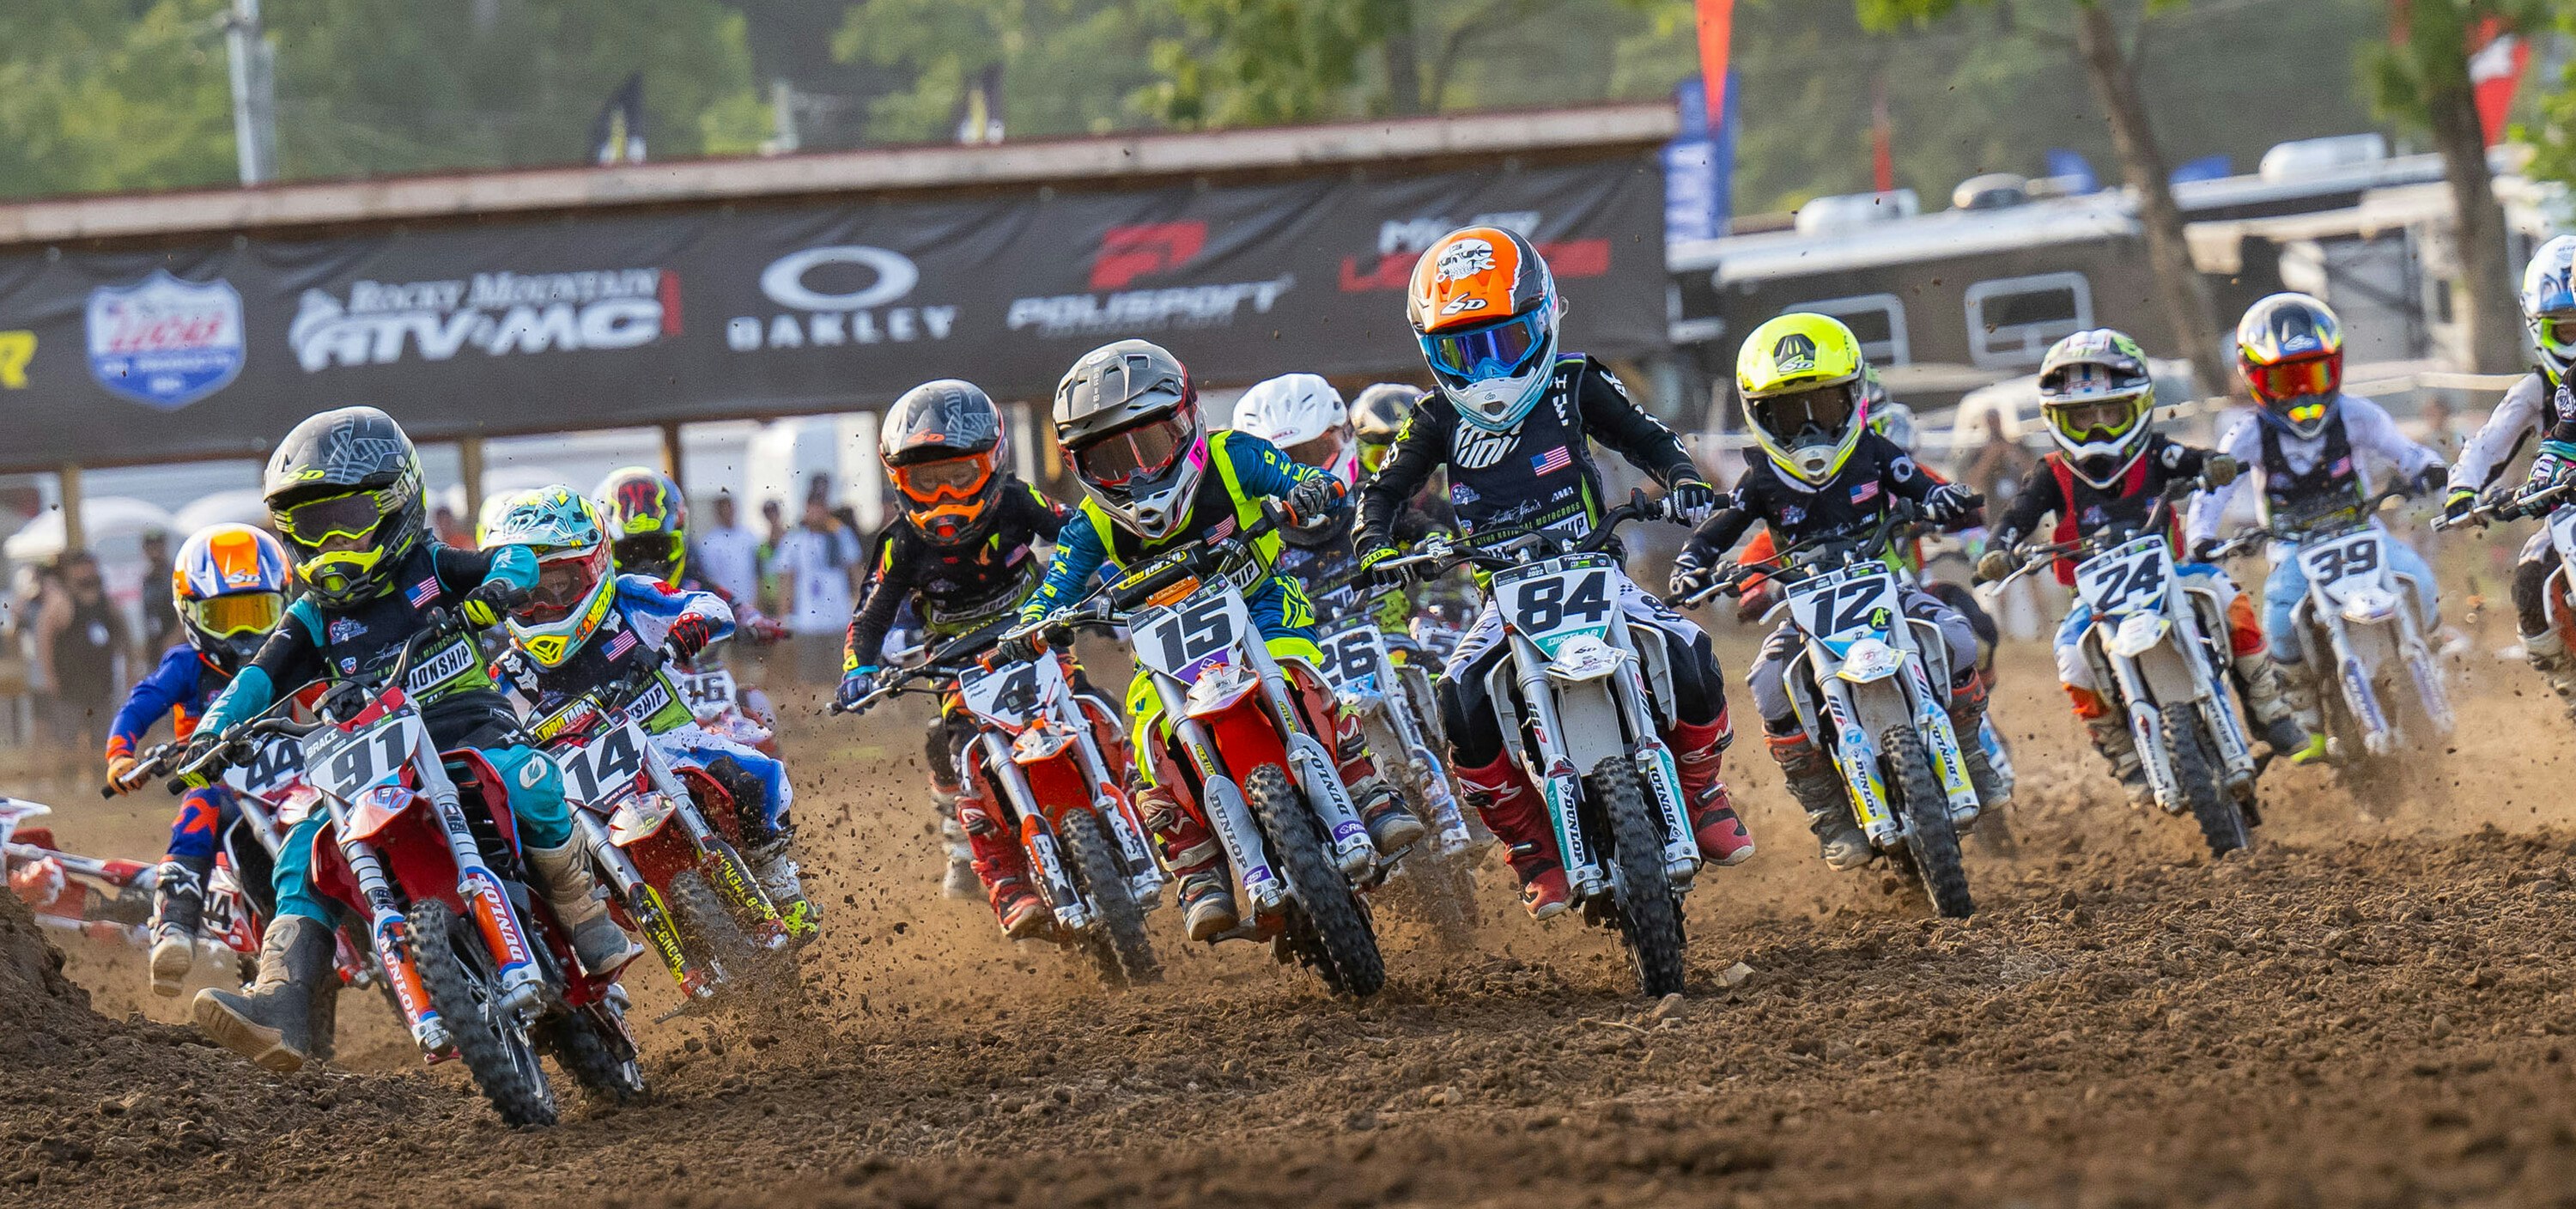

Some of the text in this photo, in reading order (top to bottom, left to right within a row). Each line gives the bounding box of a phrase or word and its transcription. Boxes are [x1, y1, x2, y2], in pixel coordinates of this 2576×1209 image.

[726, 304, 959, 352] OAKLEY
[1440, 291, 1488, 316] 6D
[2095, 552, 2166, 611] 24
[2309, 539, 2378, 586] 39
[1516, 570, 1612, 636] 84
[1808, 576, 1886, 639] 12
[1155, 595, 1233, 675] 15
[246, 738, 306, 792] 44
[305, 727, 339, 760] BRACE
[331, 721, 407, 799] 91
[564, 726, 642, 804] 14
[1855, 760, 1878, 817] DUNLOP
[1209, 793, 1249, 869] DUNLOP
[1564, 797, 1583, 863] DUNLOP
[476, 872, 526, 962] DUNLOP
